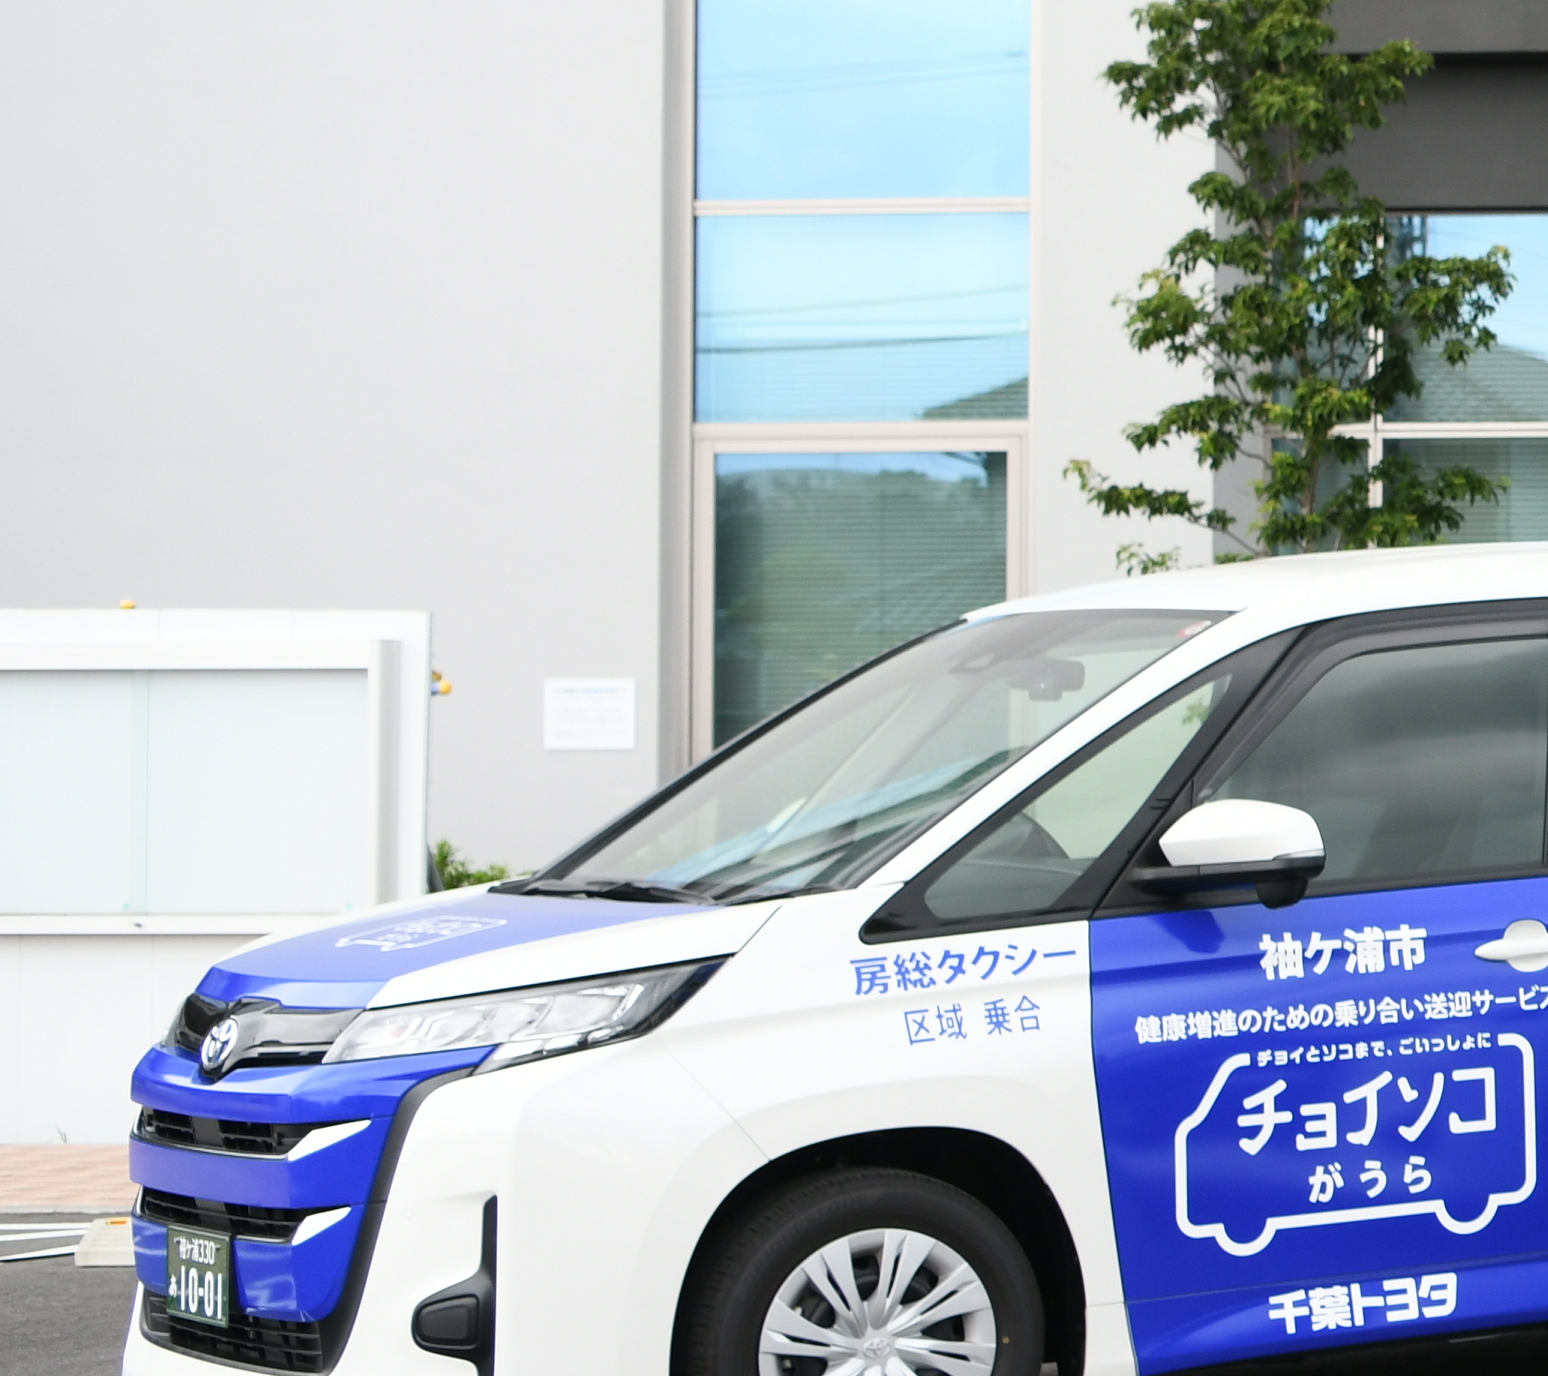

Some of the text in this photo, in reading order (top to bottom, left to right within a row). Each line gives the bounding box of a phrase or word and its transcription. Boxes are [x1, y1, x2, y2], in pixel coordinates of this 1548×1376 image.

[849, 943, 1077, 997] 房総タクシー
[1258, 926, 1427, 981] 袖ケ浦市
[903, 993, 1041, 1048] 区域 乗合
[1257, 1032, 1492, 1068] チョイとソコまで、ごいっしょに
[1237, 1068, 1498, 1157] チョイソコ
[1308, 1156, 1433, 1204] がうら
[168, 1265, 222, 1320] あ 10-01
[1268, 1272, 1458, 1336] 千葉トヨタ
